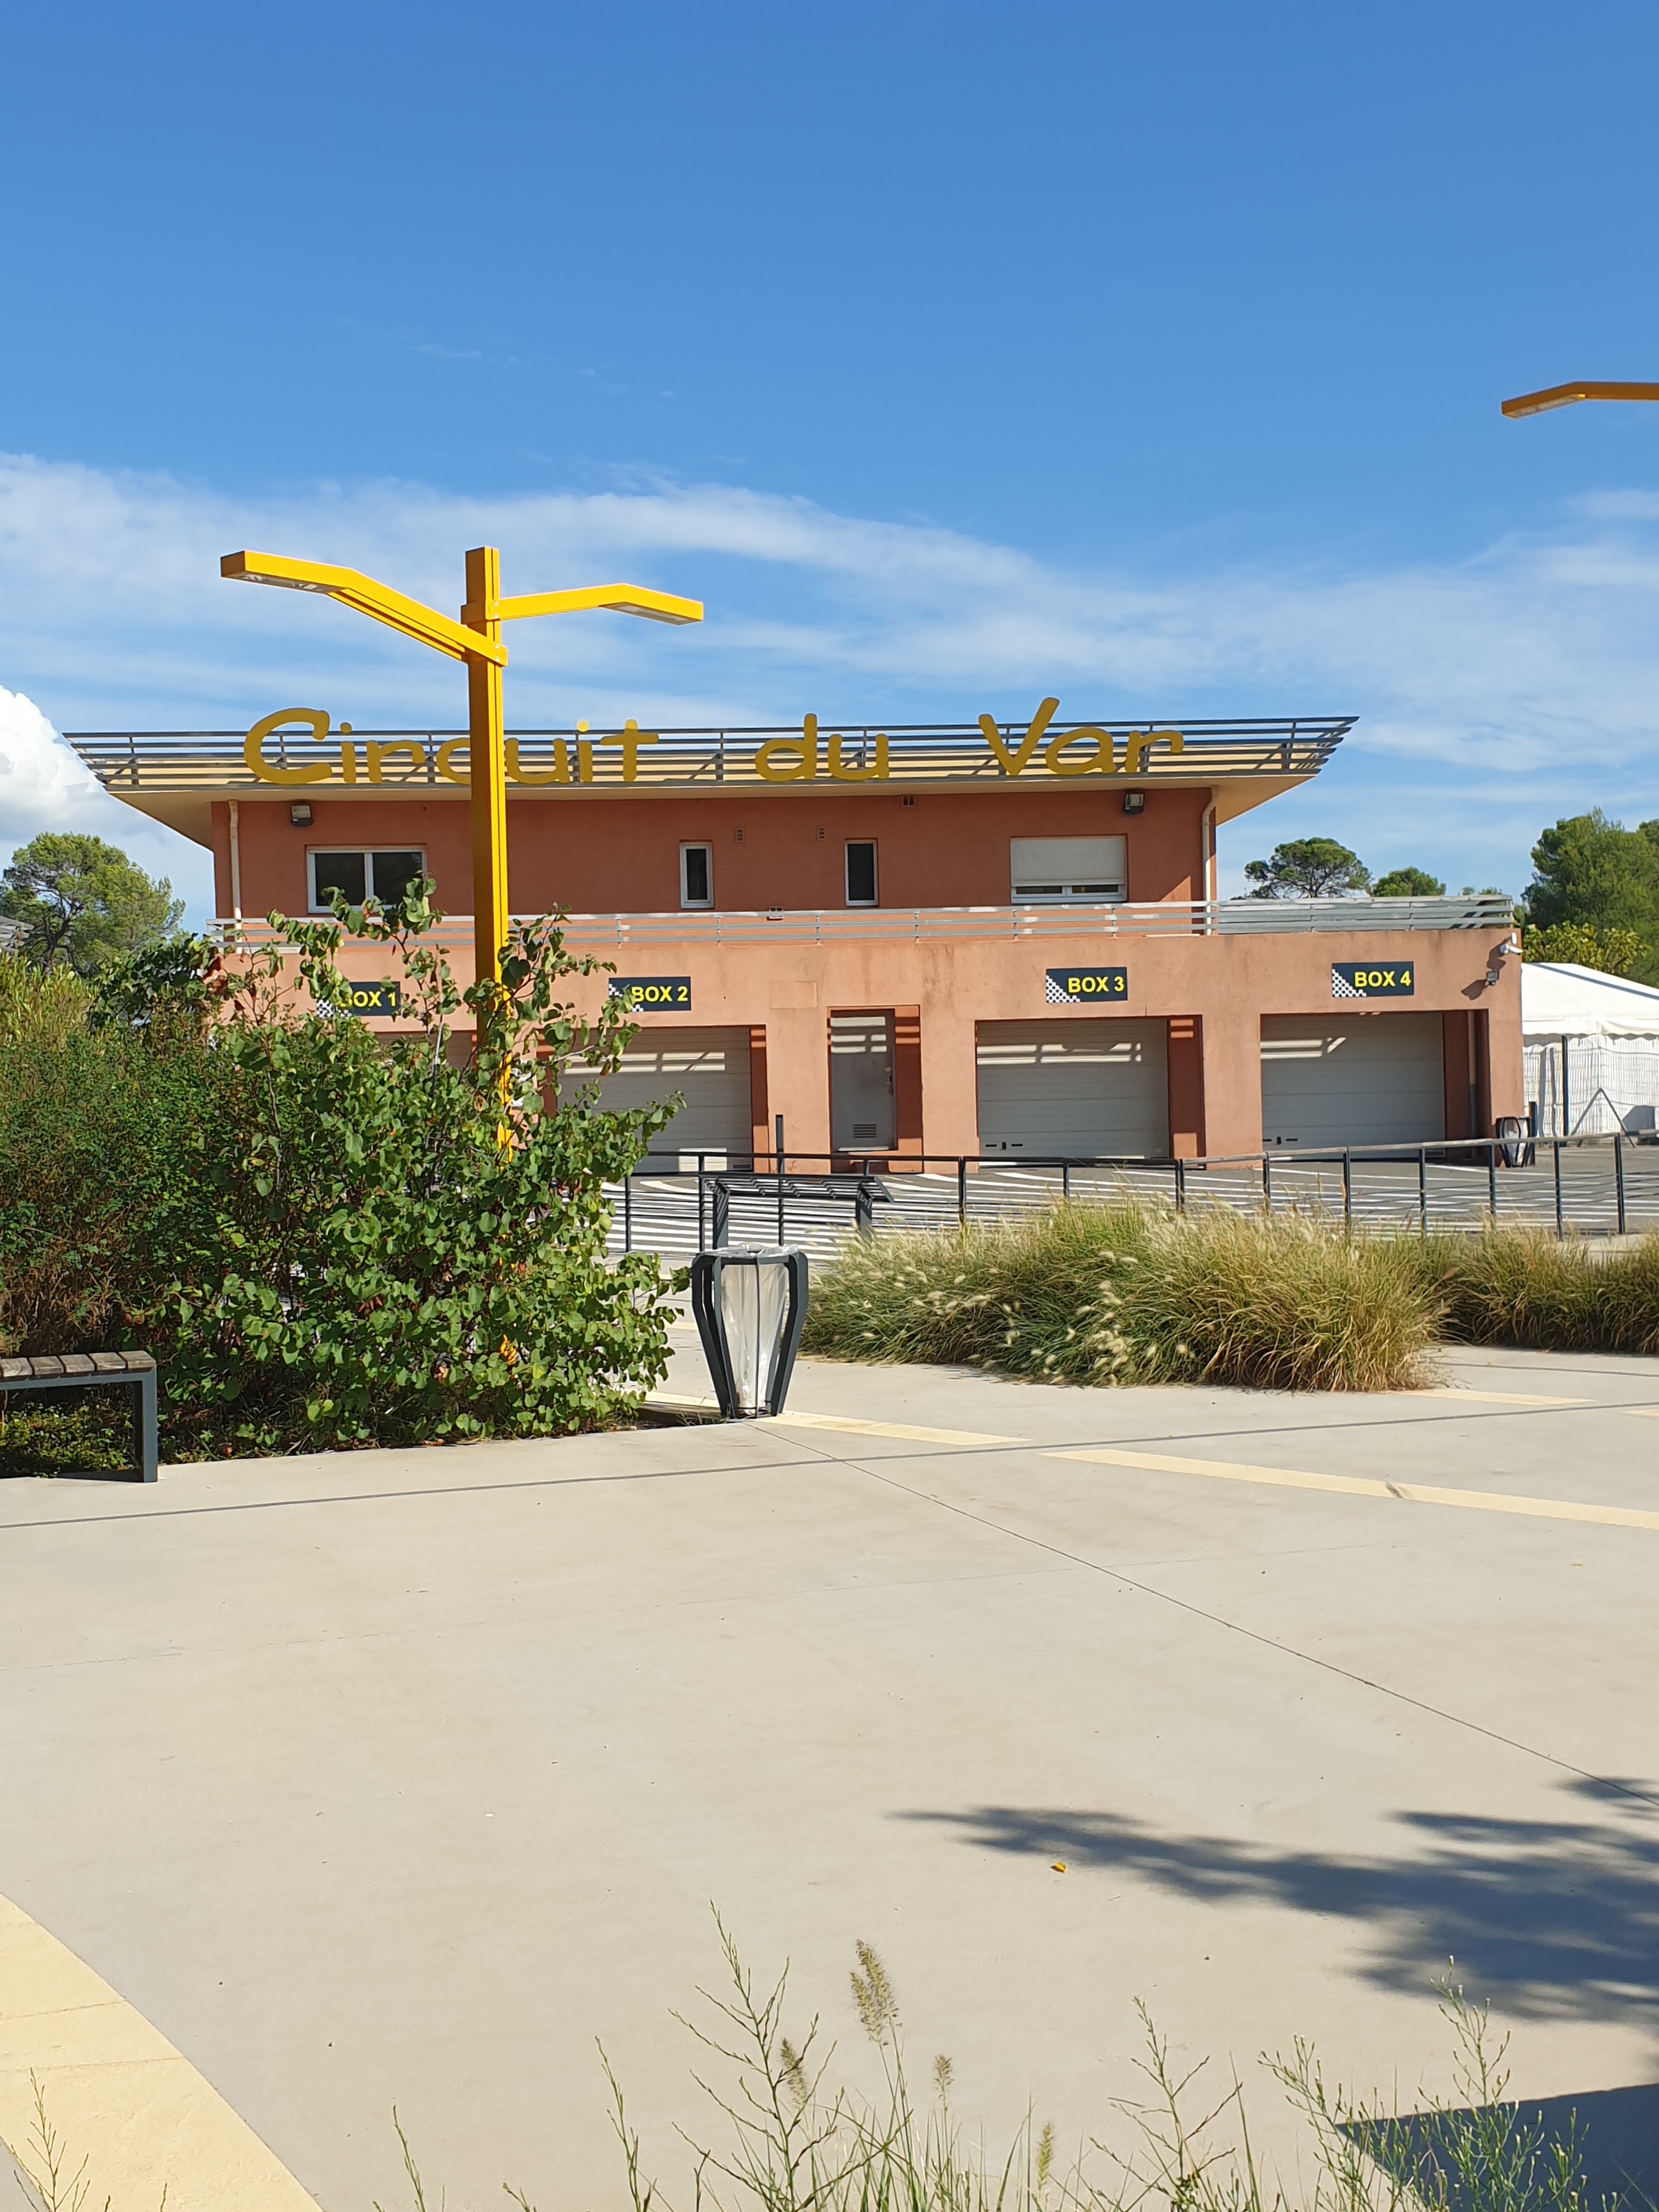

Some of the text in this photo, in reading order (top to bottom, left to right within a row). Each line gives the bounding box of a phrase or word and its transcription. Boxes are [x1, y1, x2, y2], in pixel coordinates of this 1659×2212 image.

[243, 697, 1184, 784] Circuit du Var
[1067, 976, 1124, 992] BOX 3
[1354, 970, 1411, 987] BOX 4
[387, 991, 396, 1007] 1
[631, 986, 688, 1002] BOX 2
